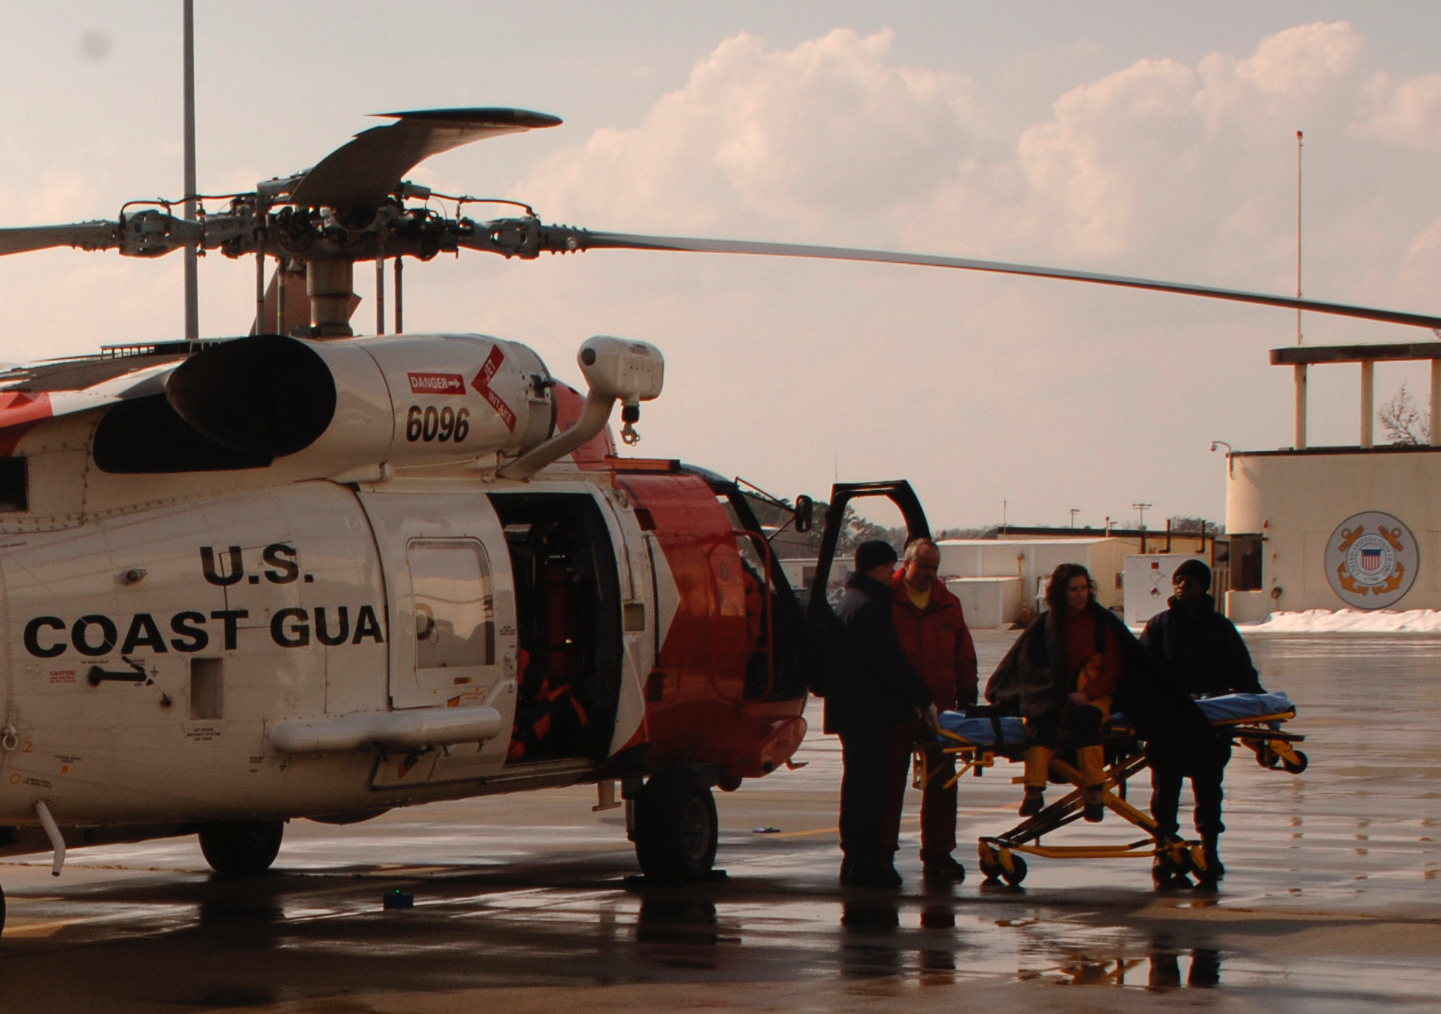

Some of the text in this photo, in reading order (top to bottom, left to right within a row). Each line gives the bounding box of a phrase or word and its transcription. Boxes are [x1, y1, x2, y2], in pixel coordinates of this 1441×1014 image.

[410, 376, 449, 389] DANGER
[483, 359, 513, 423] JET INTAKE
[406, 405, 470, 443] 6096
[200, 543, 314, 586] U.S.
[23, 604, 384, 658] COAST GUA
